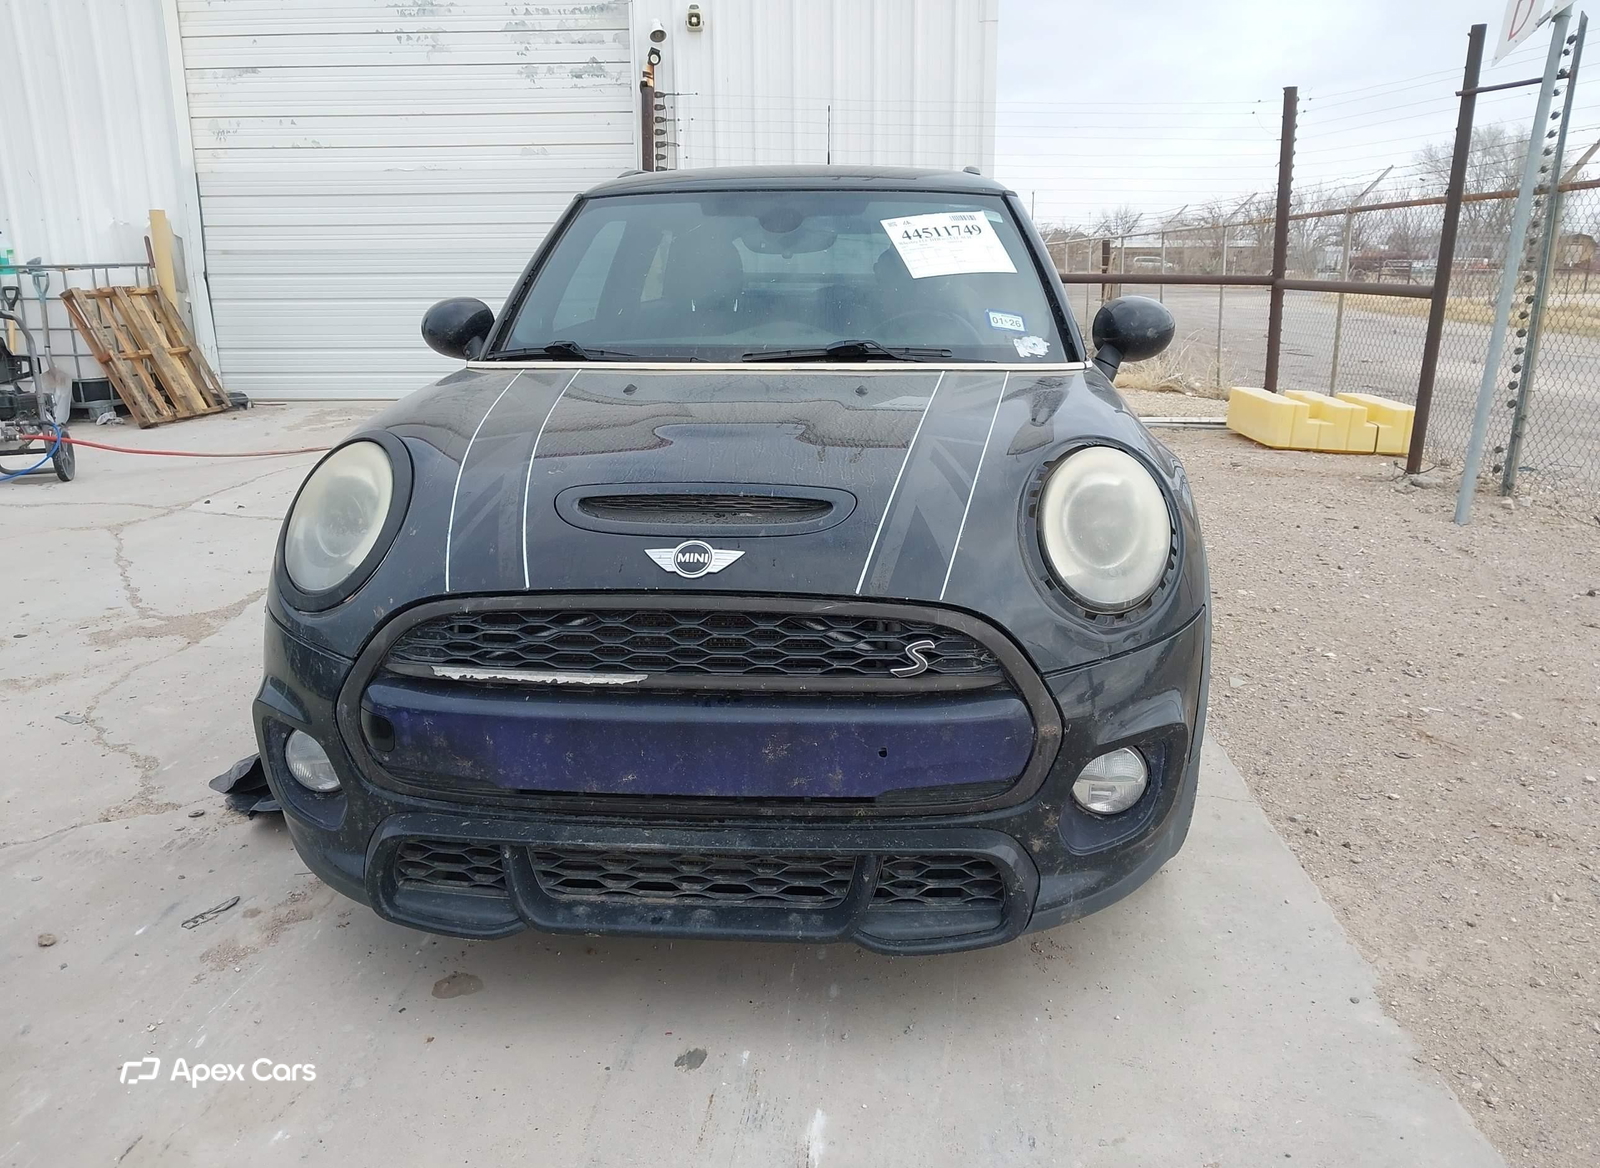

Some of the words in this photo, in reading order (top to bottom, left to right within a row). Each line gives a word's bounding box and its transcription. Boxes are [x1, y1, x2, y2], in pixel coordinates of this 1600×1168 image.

[901, 224, 982, 241] 44511749
[677, 553, 709, 563] MINI
[890, 640, 935, 678] S
